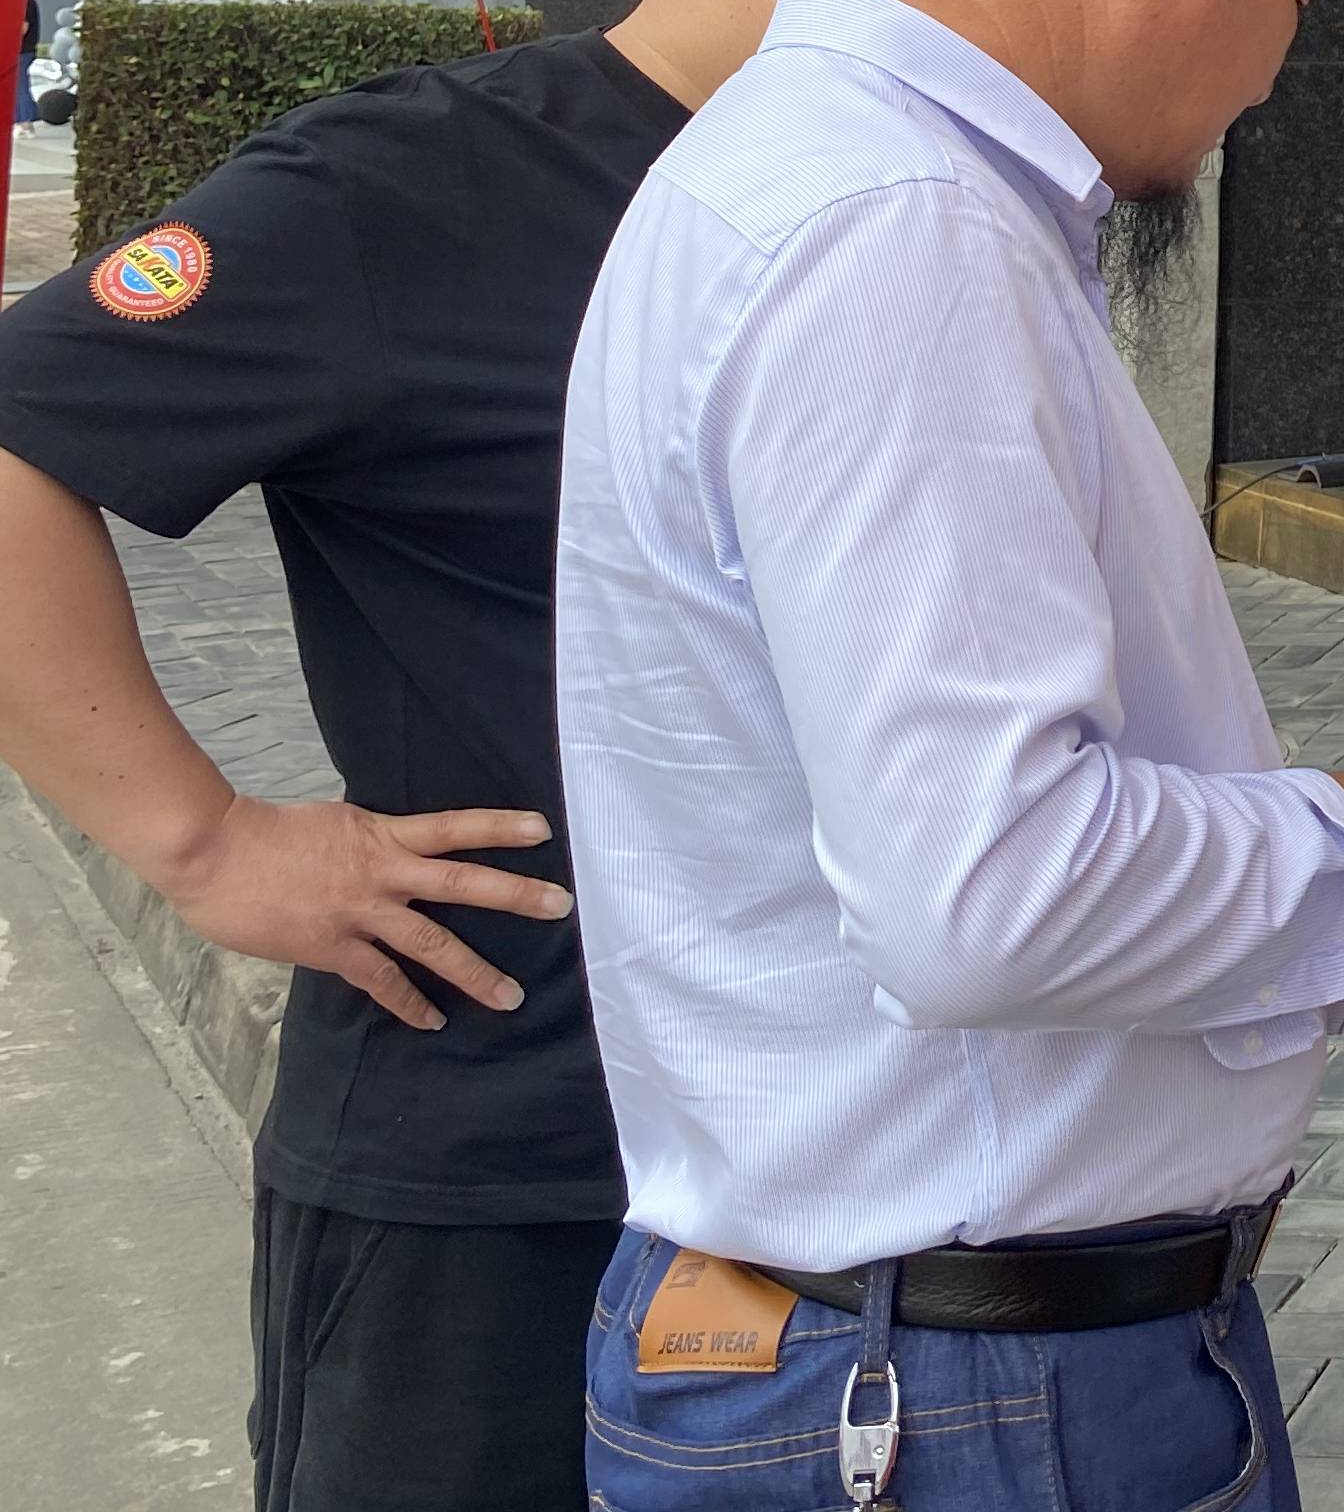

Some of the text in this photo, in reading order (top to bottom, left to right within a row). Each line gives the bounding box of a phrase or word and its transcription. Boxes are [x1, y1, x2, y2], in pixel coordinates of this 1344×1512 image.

[151, 234, 187, 249] SINCE
[658, 1331, 759, 1355] JEANS WEAR
